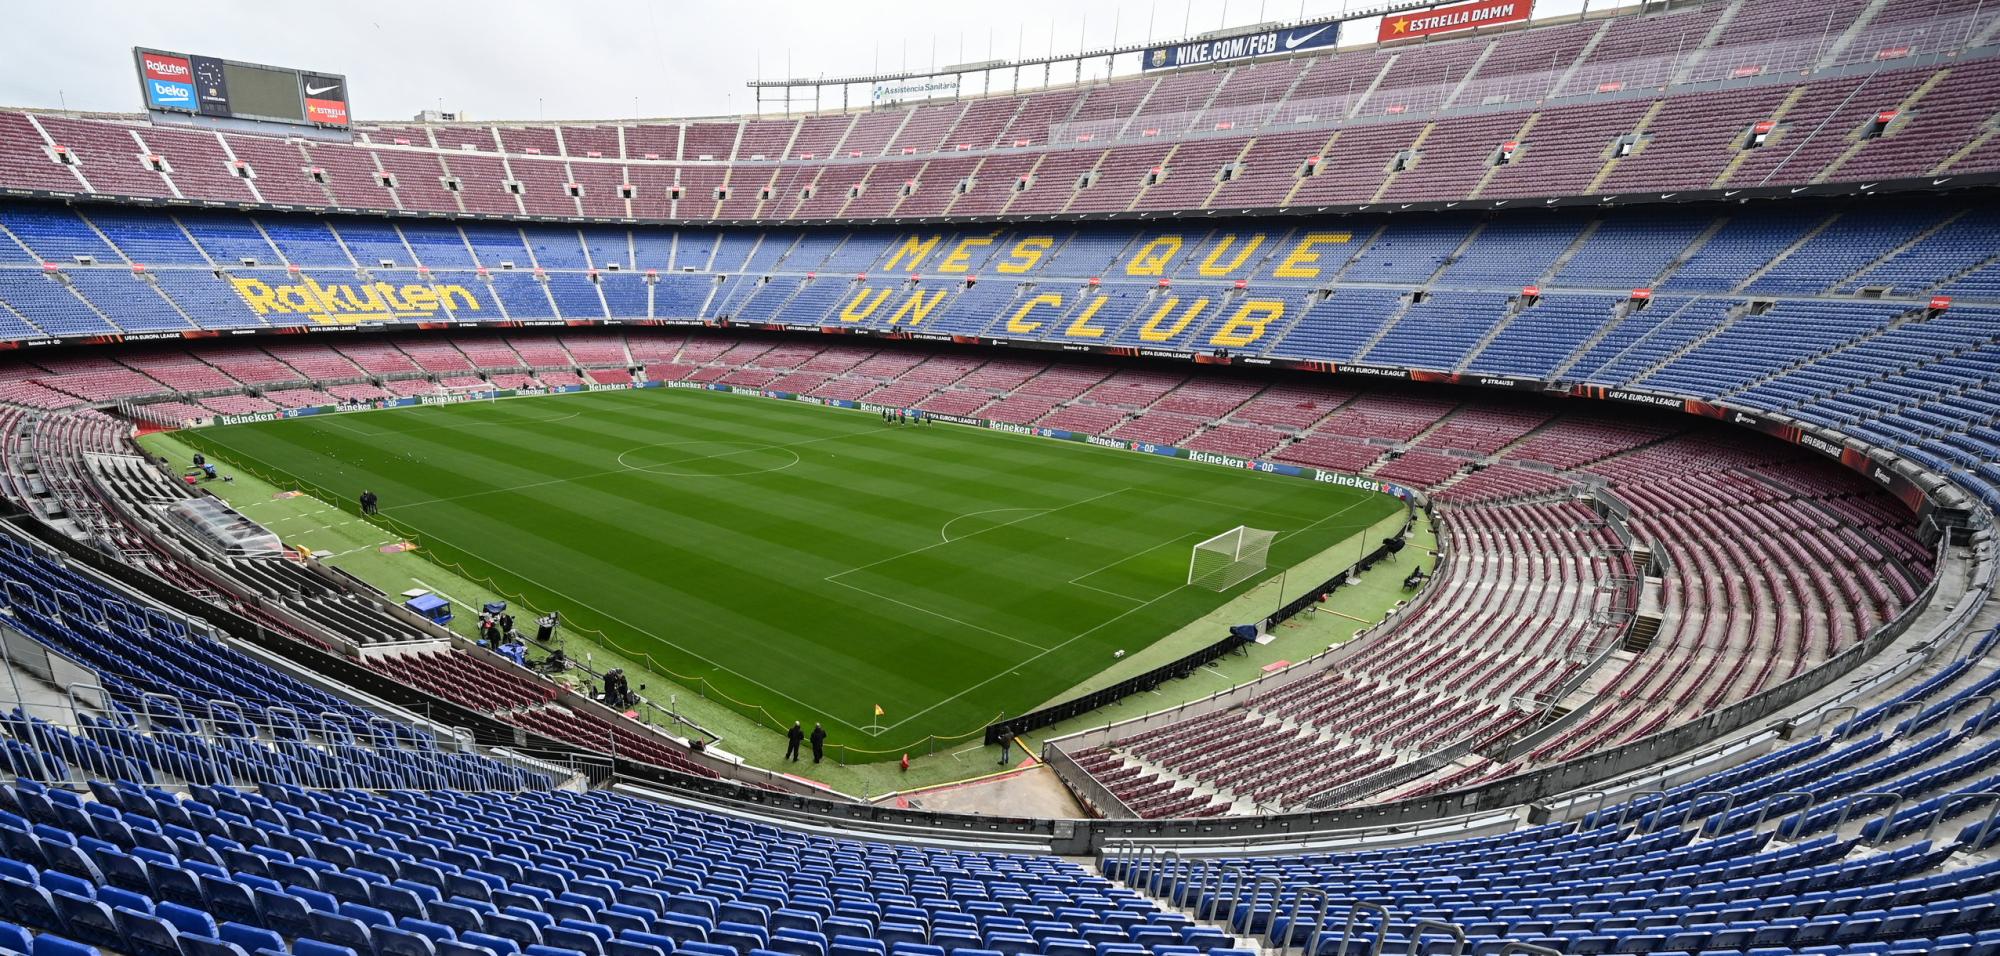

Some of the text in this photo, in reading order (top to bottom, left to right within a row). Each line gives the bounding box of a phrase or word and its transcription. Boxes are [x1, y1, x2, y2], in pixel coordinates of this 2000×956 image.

[1409, 4, 1514, 32] ESTRELLA DAMM
[1175, 33, 1277, 64] NIKE.COM/FCB
[146, 60, 189, 75] Rakuten
[155, 82, 189, 97] beko
[316, 107, 346, 116] ESTRELLA
[1126, 231, 1353, 278] QUE
[229, 277, 480, 318] Rakuten
[839, 286, 1286, 347] UN CLUB
[1355, 367, 1380, 375] EUROPA
[1380, 369, 1406, 377] LEAGUE
[589, 383, 625, 392] Heineken
[1609, 391, 1682, 407] UEFA EUROPA LEAGUE
[223, 413, 275, 426] Heineken
[989, 420, 1031, 434] Heineken
[1189, 450, 1244, 468] Heineken
[1315, 469, 1379, 491] Heineken
